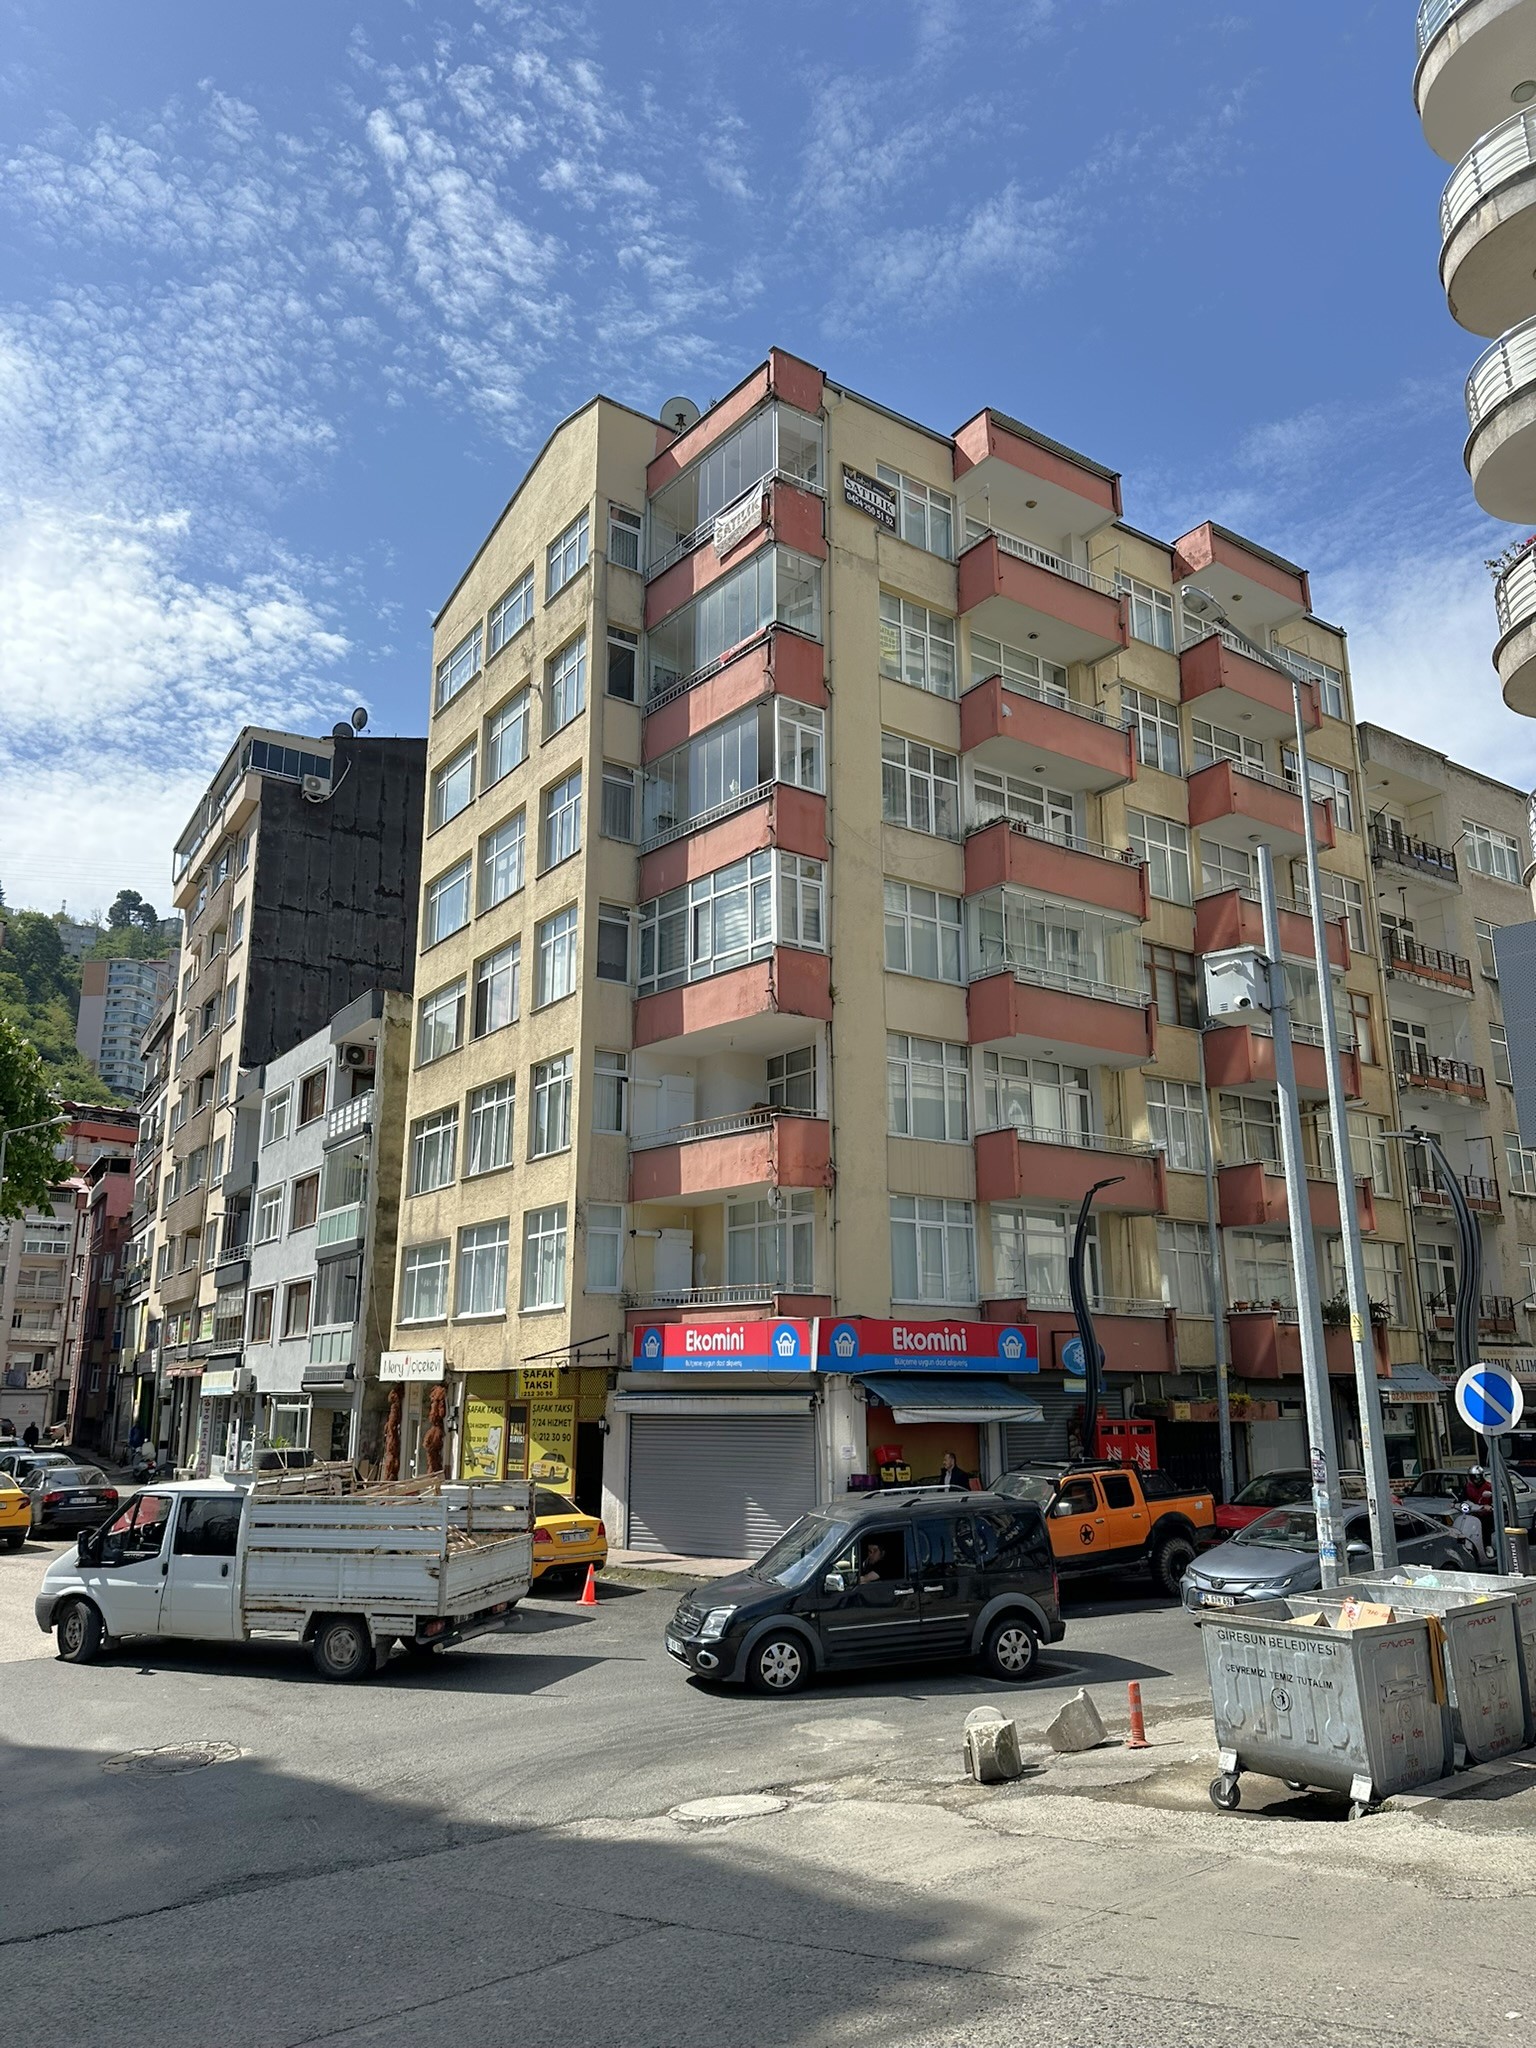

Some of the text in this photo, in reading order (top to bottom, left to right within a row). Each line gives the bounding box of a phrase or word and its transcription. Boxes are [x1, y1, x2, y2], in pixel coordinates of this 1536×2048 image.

[846, 478, 893, 514] SATILIK
[846, 492, 863, 507] 0454
[876, 510, 884, 521] 51
[886, 515, 894, 527] 52
[686, 1327, 744, 1352] Ekomini
[893, 1327, 967, 1352] Ekomini
[522, 1370, 555, 1380] ŞAFAK
[532, 1418, 572, 1428] 7/24 HİZMET
[539, 1433, 572, 1442] 212 30 90
[1269, 1637, 1337, 1656] BELEDİYESİ
[1379, 1638, 1414, 1650] FAVORI
[1297, 1676, 1333, 1689] TUTALIM
